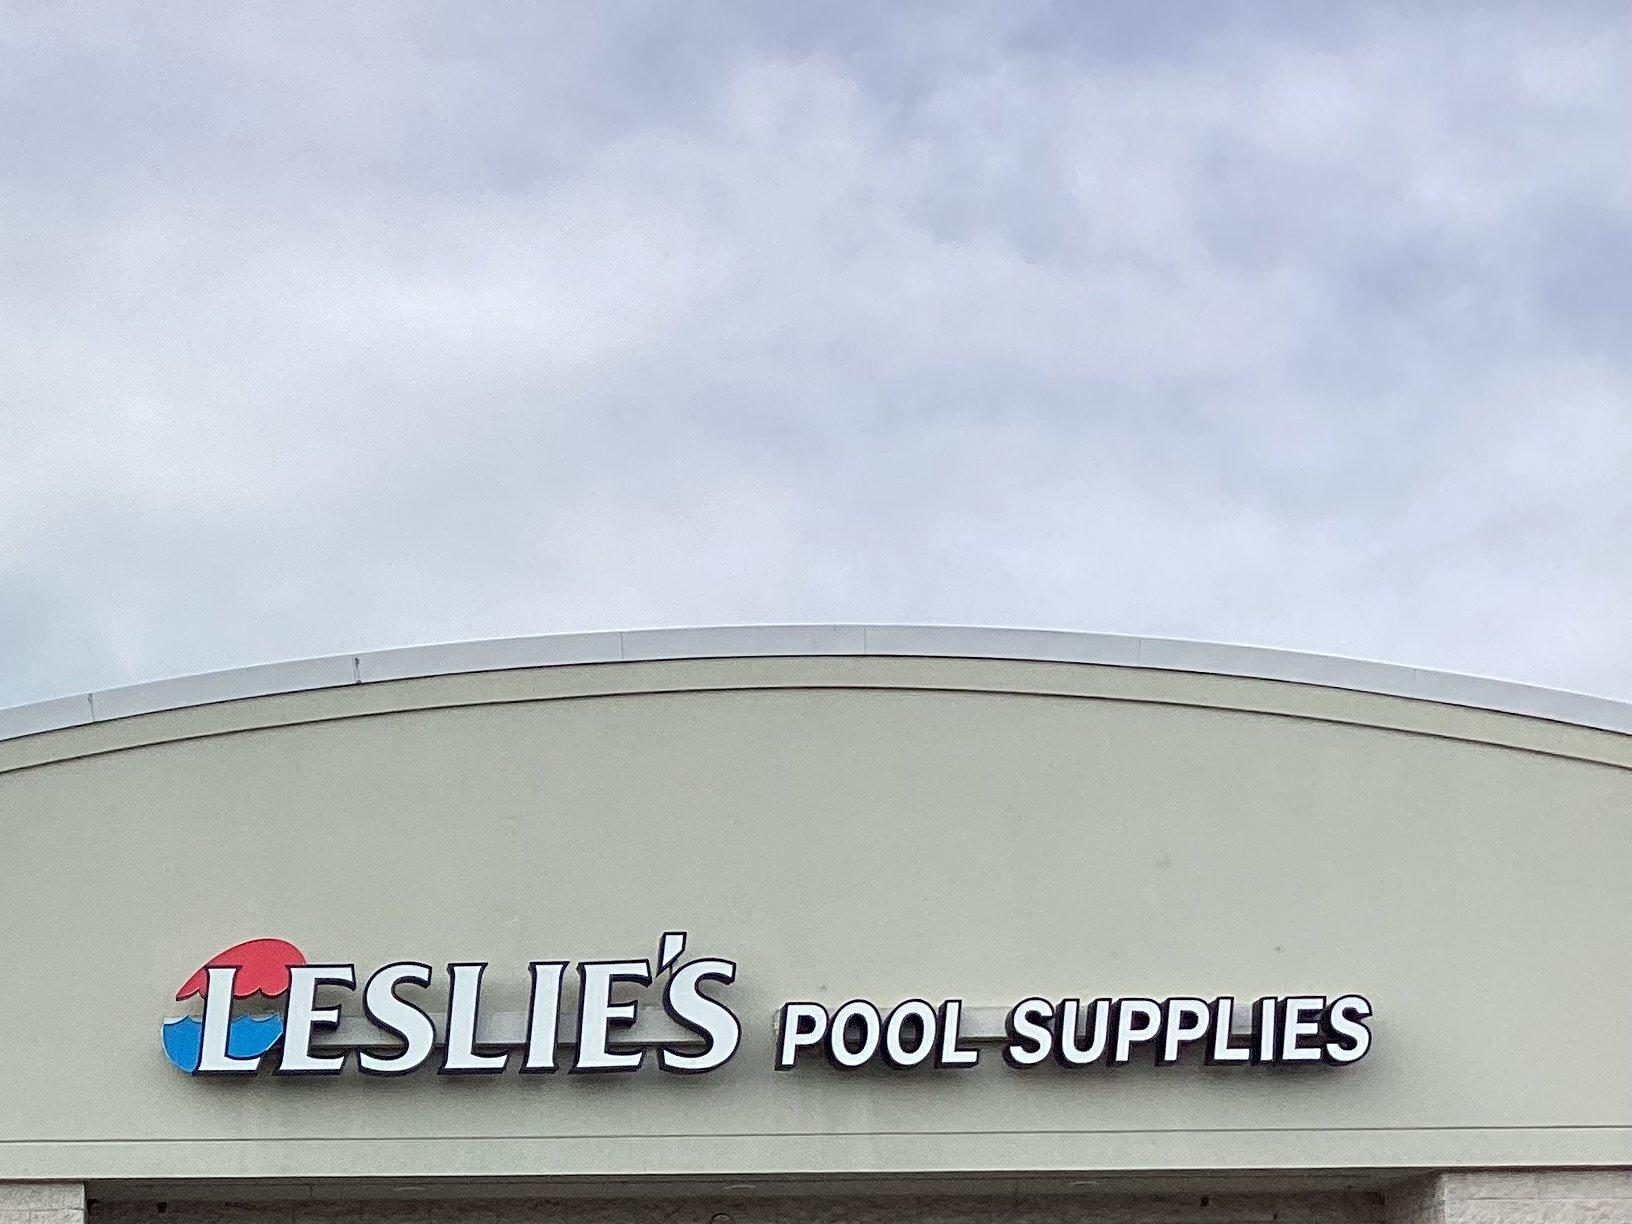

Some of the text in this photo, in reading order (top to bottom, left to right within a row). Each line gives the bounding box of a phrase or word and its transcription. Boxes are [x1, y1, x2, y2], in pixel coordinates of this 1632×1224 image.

[192, 931, 1373, 1076] LESLIE'S POOL SUPPLIES
